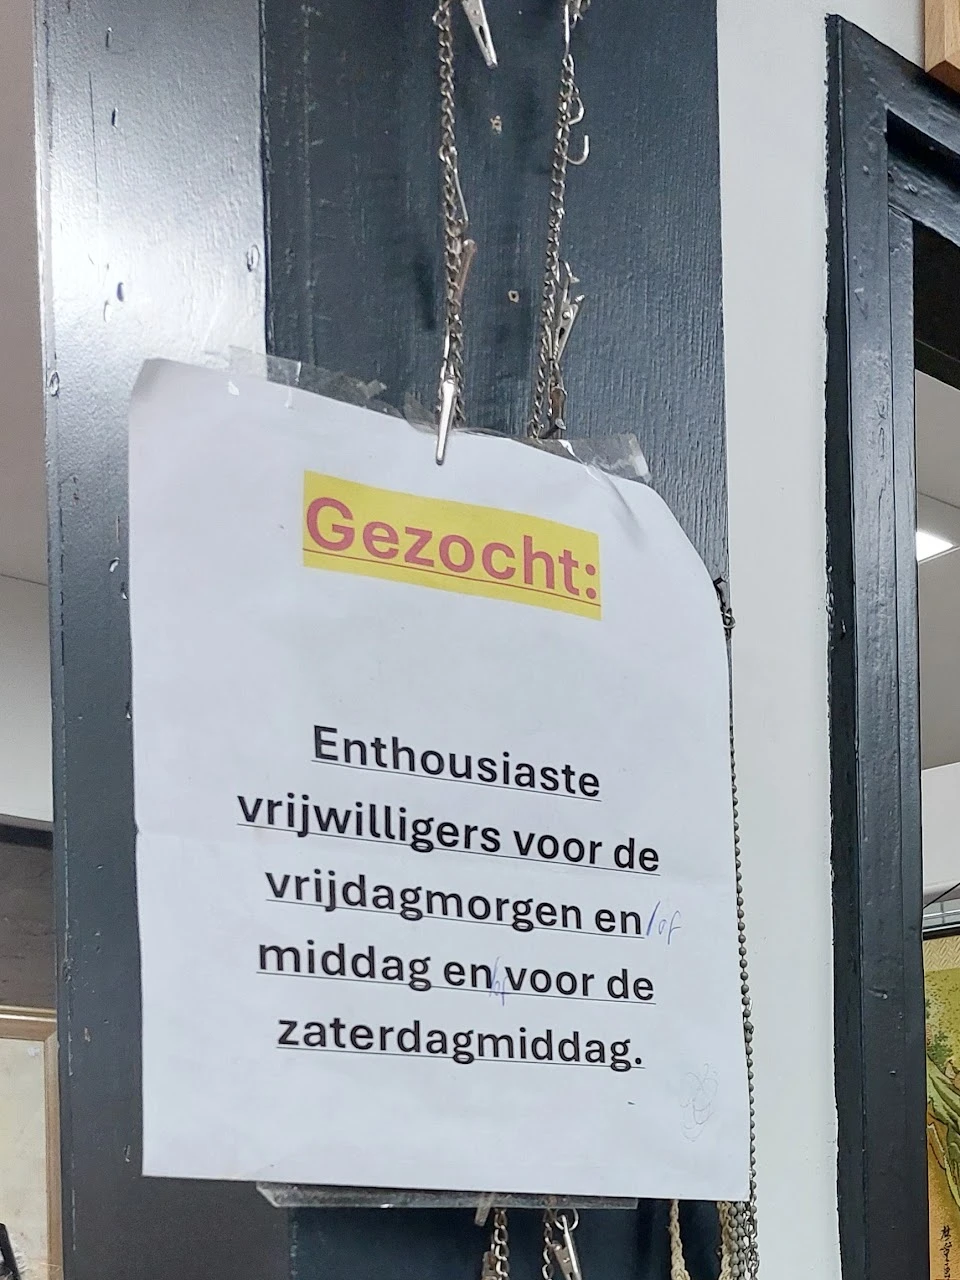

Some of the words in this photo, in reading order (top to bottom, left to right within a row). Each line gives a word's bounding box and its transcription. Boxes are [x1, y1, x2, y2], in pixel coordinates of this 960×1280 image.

[305, 495, 598, 601] Gezocht:
[313, 724, 601, 799] Enthousiaste
[237, 791, 502, 852] vrijwilligers
[513, 828, 602, 867] voor
[613, 836, 660, 873] de
[265, 867, 582, 932] vrijdagmorgen
[594, 899, 642, 937] en
[258, 939, 431, 993] middag
[443, 961, 492, 989] en
[504, 965, 595, 1000] voor
[606, 962, 654, 1003] de
[277, 1015, 643, 1072] zaterdagmiddag.
